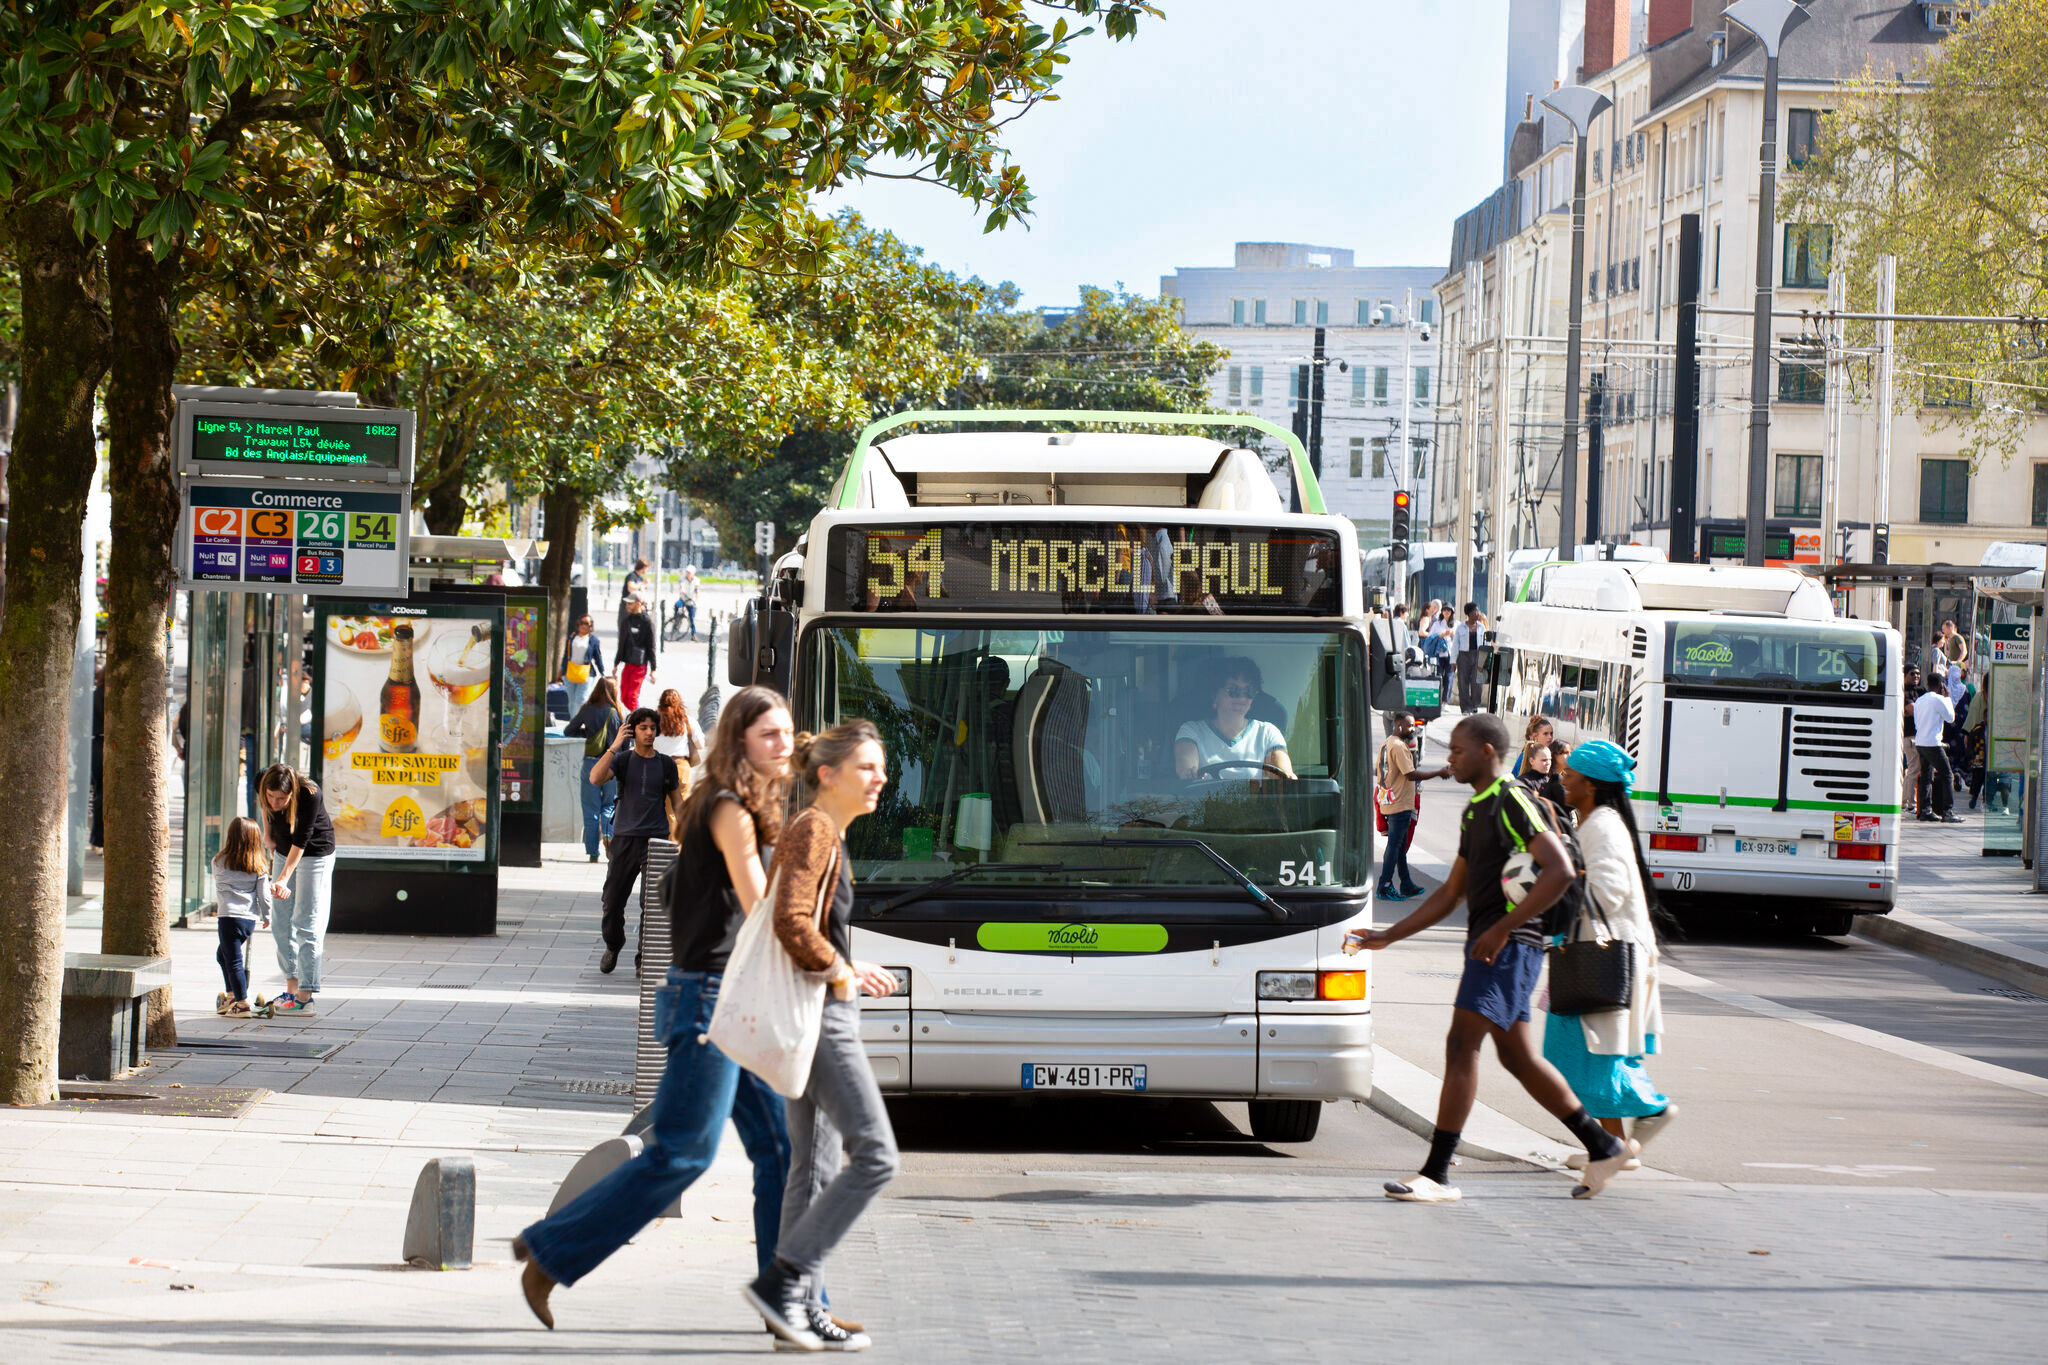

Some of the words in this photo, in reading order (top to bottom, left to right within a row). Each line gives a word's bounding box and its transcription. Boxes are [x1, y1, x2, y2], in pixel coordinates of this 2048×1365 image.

[197, 421, 226, 434] Ligne
[229, 422, 241, 433] 54
[257, 424, 292, 435] Marcel
[297, 425, 320, 437] Paul
[365, 425, 397, 436] 16H22
[244, 435, 289, 447] Travaux
[293, 438, 312, 448] L54
[317, 439, 350, 450] déviée
[225, 446, 239, 458] Bd
[243, 448, 262, 458] des
[251, 491, 343, 508] Commerce
[200, 509, 238, 535] C2
[251, 511, 288, 537] C3
[302, 513, 339, 539] 26
[355, 515, 391, 541] 54
[1794, 535, 1821, 547] CO
[199, 552, 215, 560] Nuit
[220, 555, 234, 563] NC
[250, 554, 266, 562] Nuit
[271, 556, 286, 565] NN
[867, 528, 945, 599] 54
[990, 539, 1156, 594] MARCEL
[1172, 541, 1283, 595] PAUL
[304, 559, 314, 571] 2
[326, 560, 335, 572] 3
[390, 606, 428, 615] JCDecaux
[2015, 627, 2030, 638] Co
[1817, 649, 1846, 675] 26
[1841, 678, 1869, 692] 529
[352, 755, 399, 767] CETTE
[401, 756, 458, 769] SAVEUR
[377, 770, 395, 782] EN
[388, 808, 421, 832] Leffe
[1277, 860, 1333, 887] 541
[1676, 871, 1692, 889] 70
[943, 988, 1044, 997] HEULIEZ
[1034, 1067, 1133, 1086] CW-491-PR
[1135, 1079, 1145, 1088] 44
